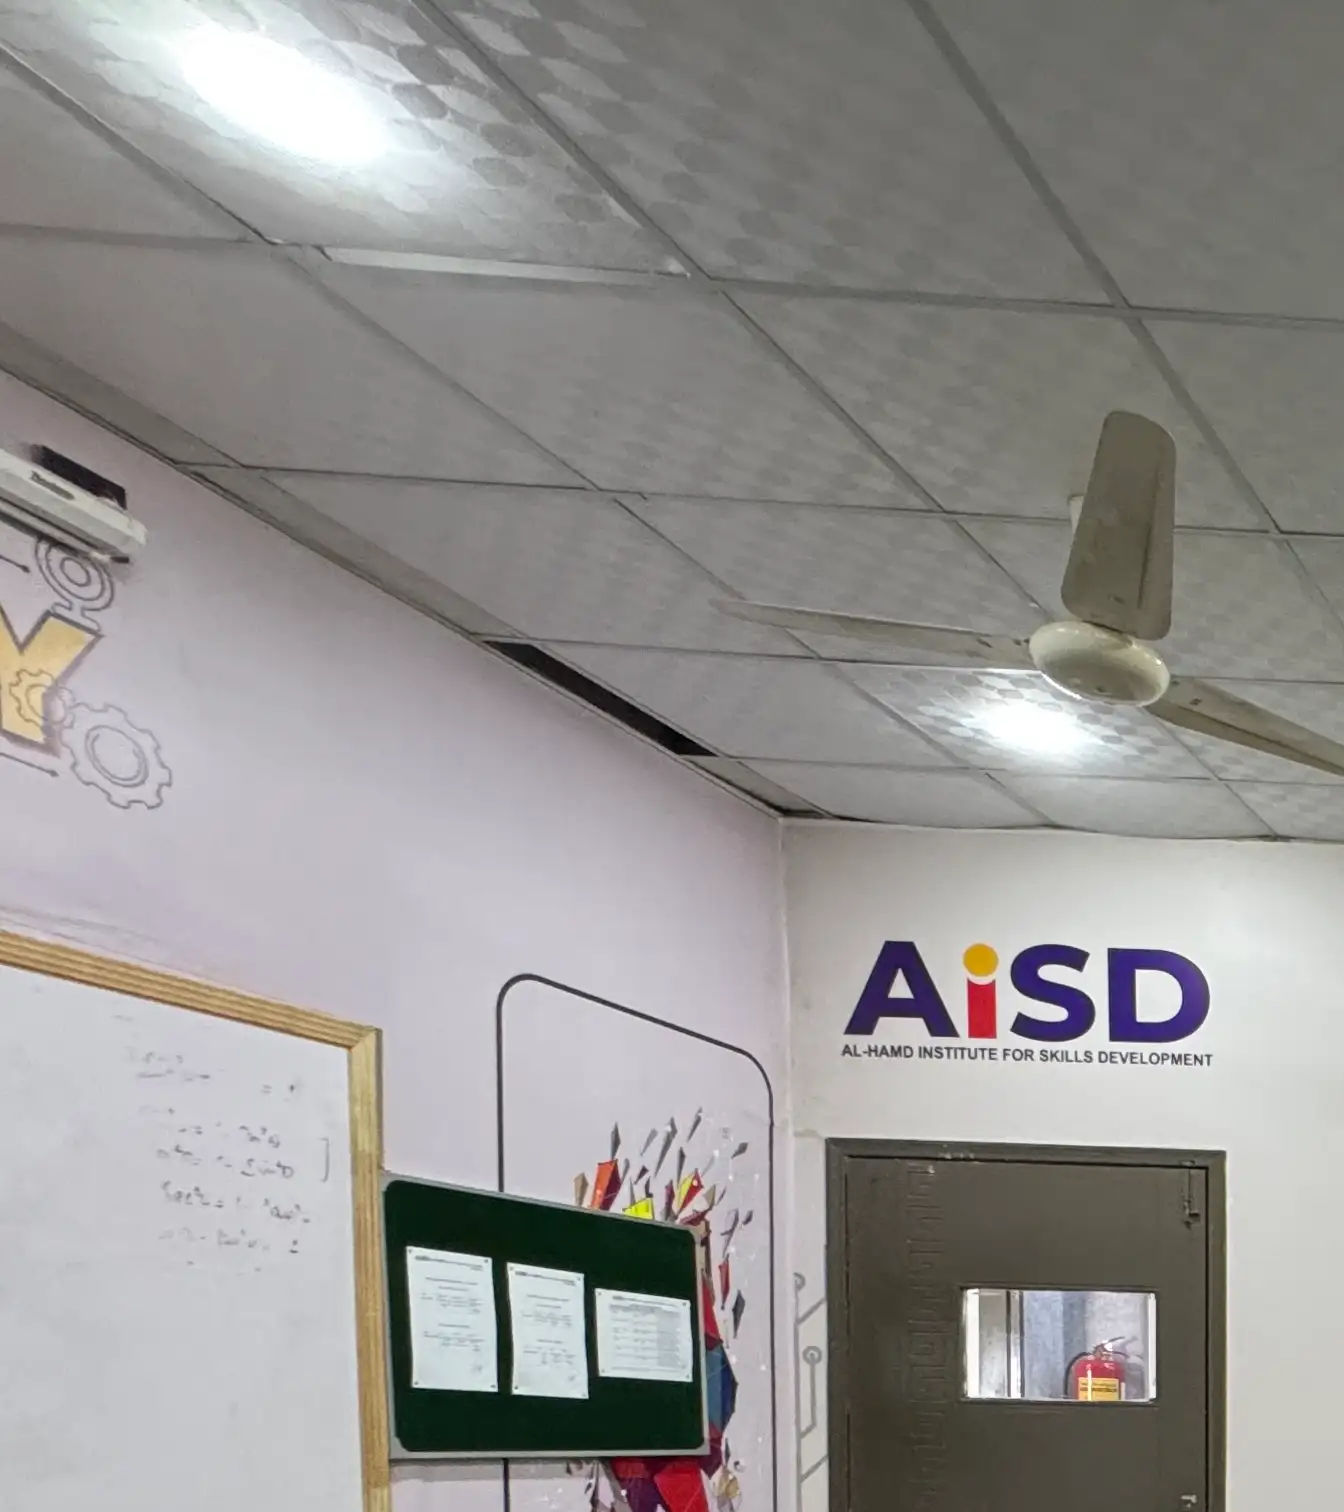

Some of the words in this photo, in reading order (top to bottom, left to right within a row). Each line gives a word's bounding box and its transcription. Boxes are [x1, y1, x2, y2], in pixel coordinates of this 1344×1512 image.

[843, 940, 1211, 1043] AiSD
[841, 1044, 913, 1059] AL-HAMD
[918, 1046, 999, 1061] INSTITUTE
[1002, 1048, 1034, 1062] FOR
[1039, 1050, 1094, 1063] SKILLS
[1098, 1051, 1213, 1067] DEVELOPMENT
